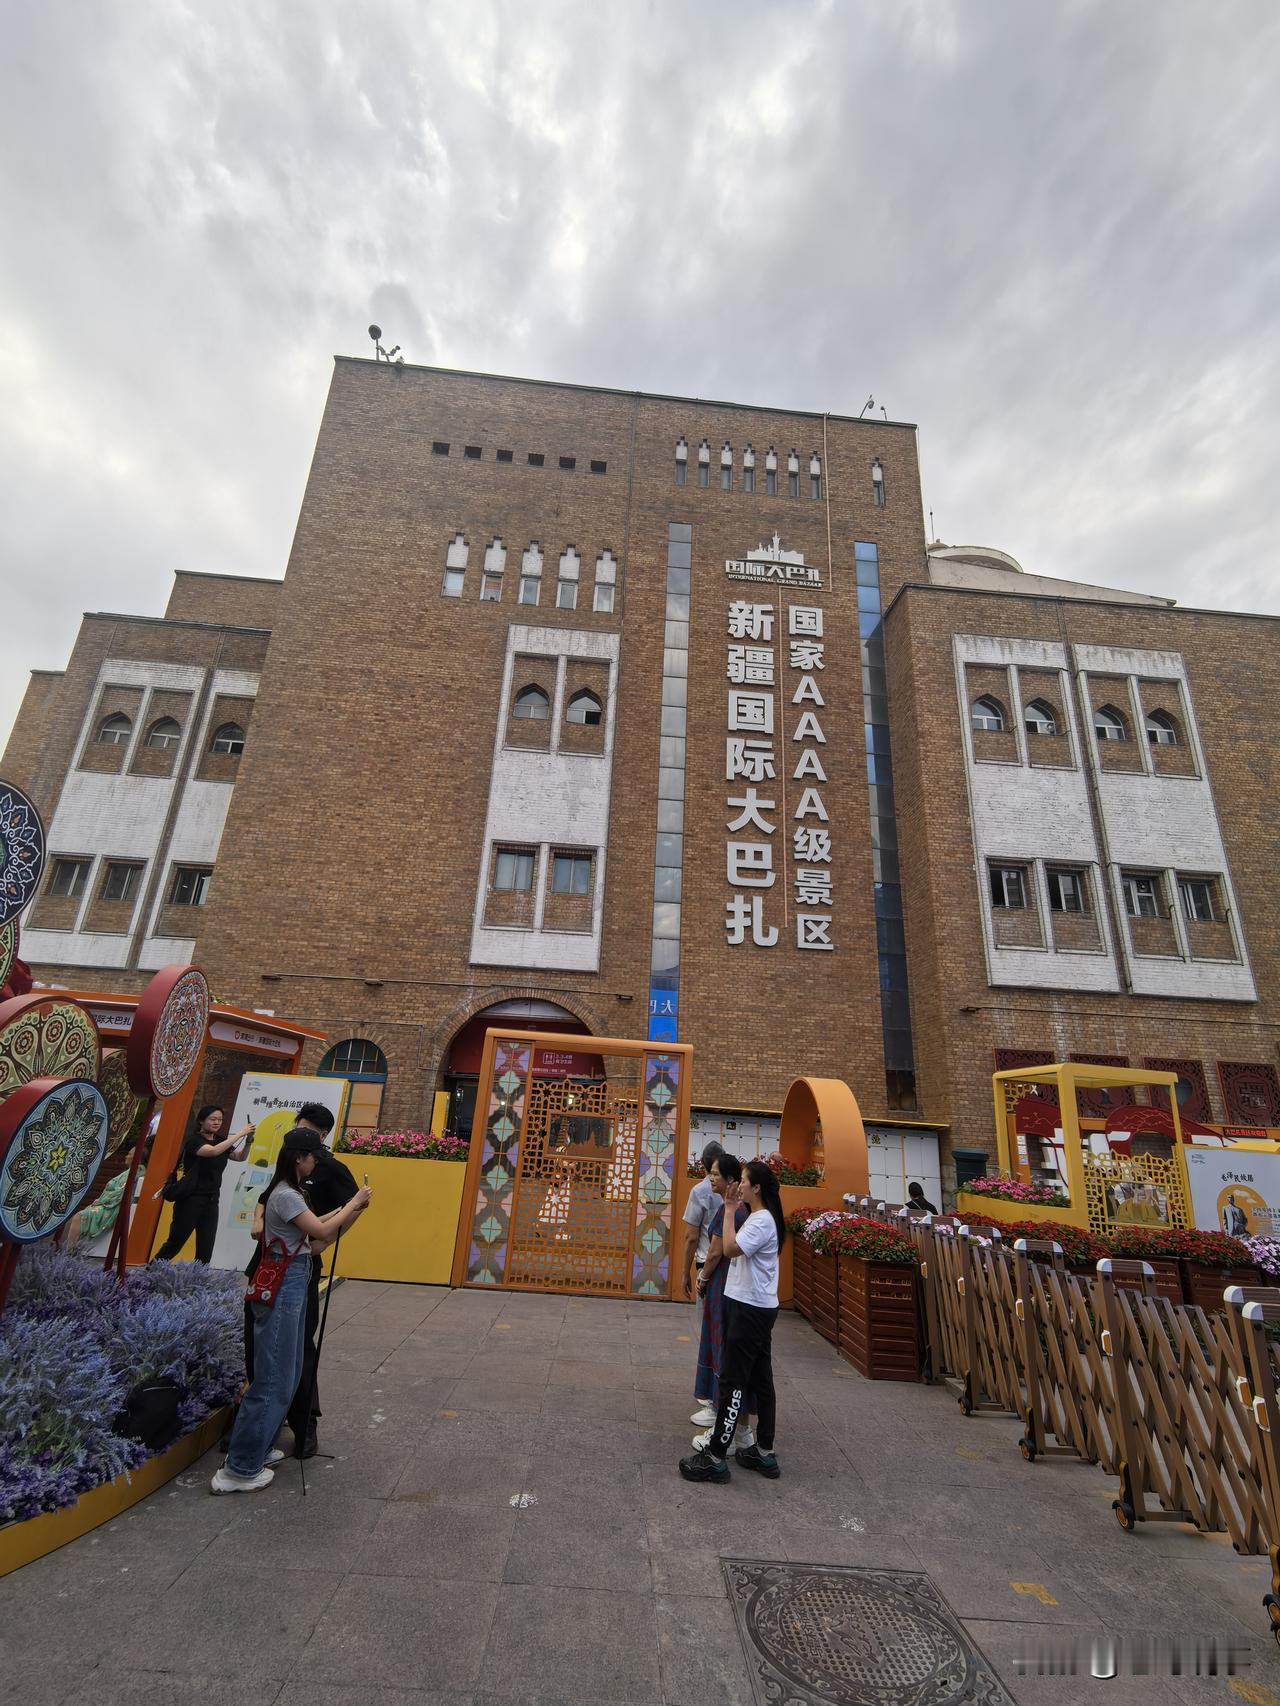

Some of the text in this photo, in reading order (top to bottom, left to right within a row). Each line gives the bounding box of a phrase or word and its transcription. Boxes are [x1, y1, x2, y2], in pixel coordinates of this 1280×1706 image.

[725, 559, 825, 583] 国际大巴扎
[728, 574, 776, 583] INTERNATIONAL
[798, 580, 823, 588] BAZAAR
[725, 600, 779, 948] 新疆国际大巴扎
[788, 604, 834, 950] 国家AAAA级景区
[95, 1014, 131, 1026] 际大巴扎
[720, 1389, 742, 1444] adidas
